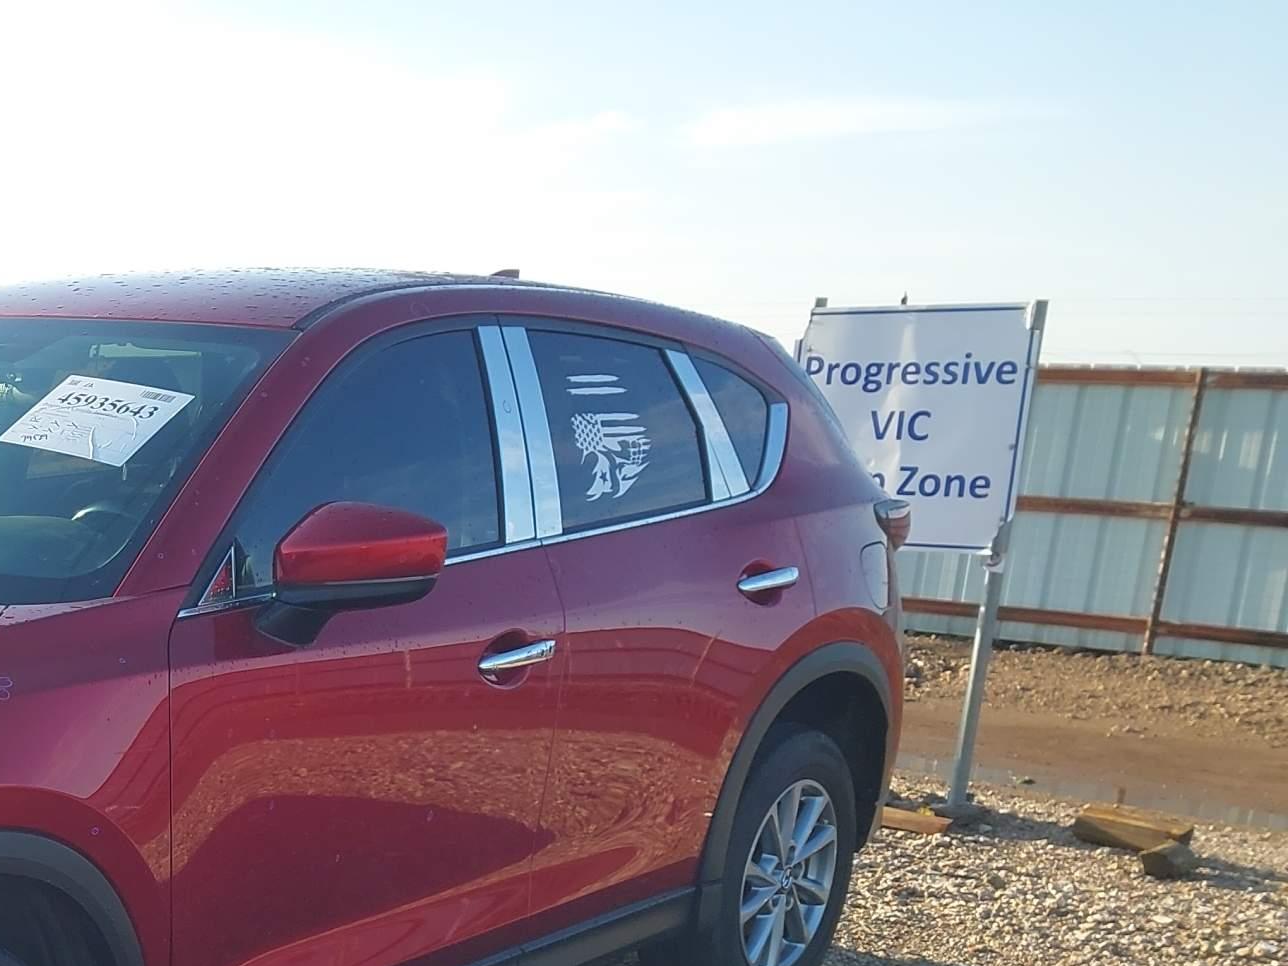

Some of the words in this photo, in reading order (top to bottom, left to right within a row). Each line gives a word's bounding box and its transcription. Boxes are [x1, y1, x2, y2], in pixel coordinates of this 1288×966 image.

[805, 352, 1018, 393] Progressive
[57, 391, 160, 420] 45935643
[870, 409, 932, 442] VIC
[895, 465, 992, 499] Zone
